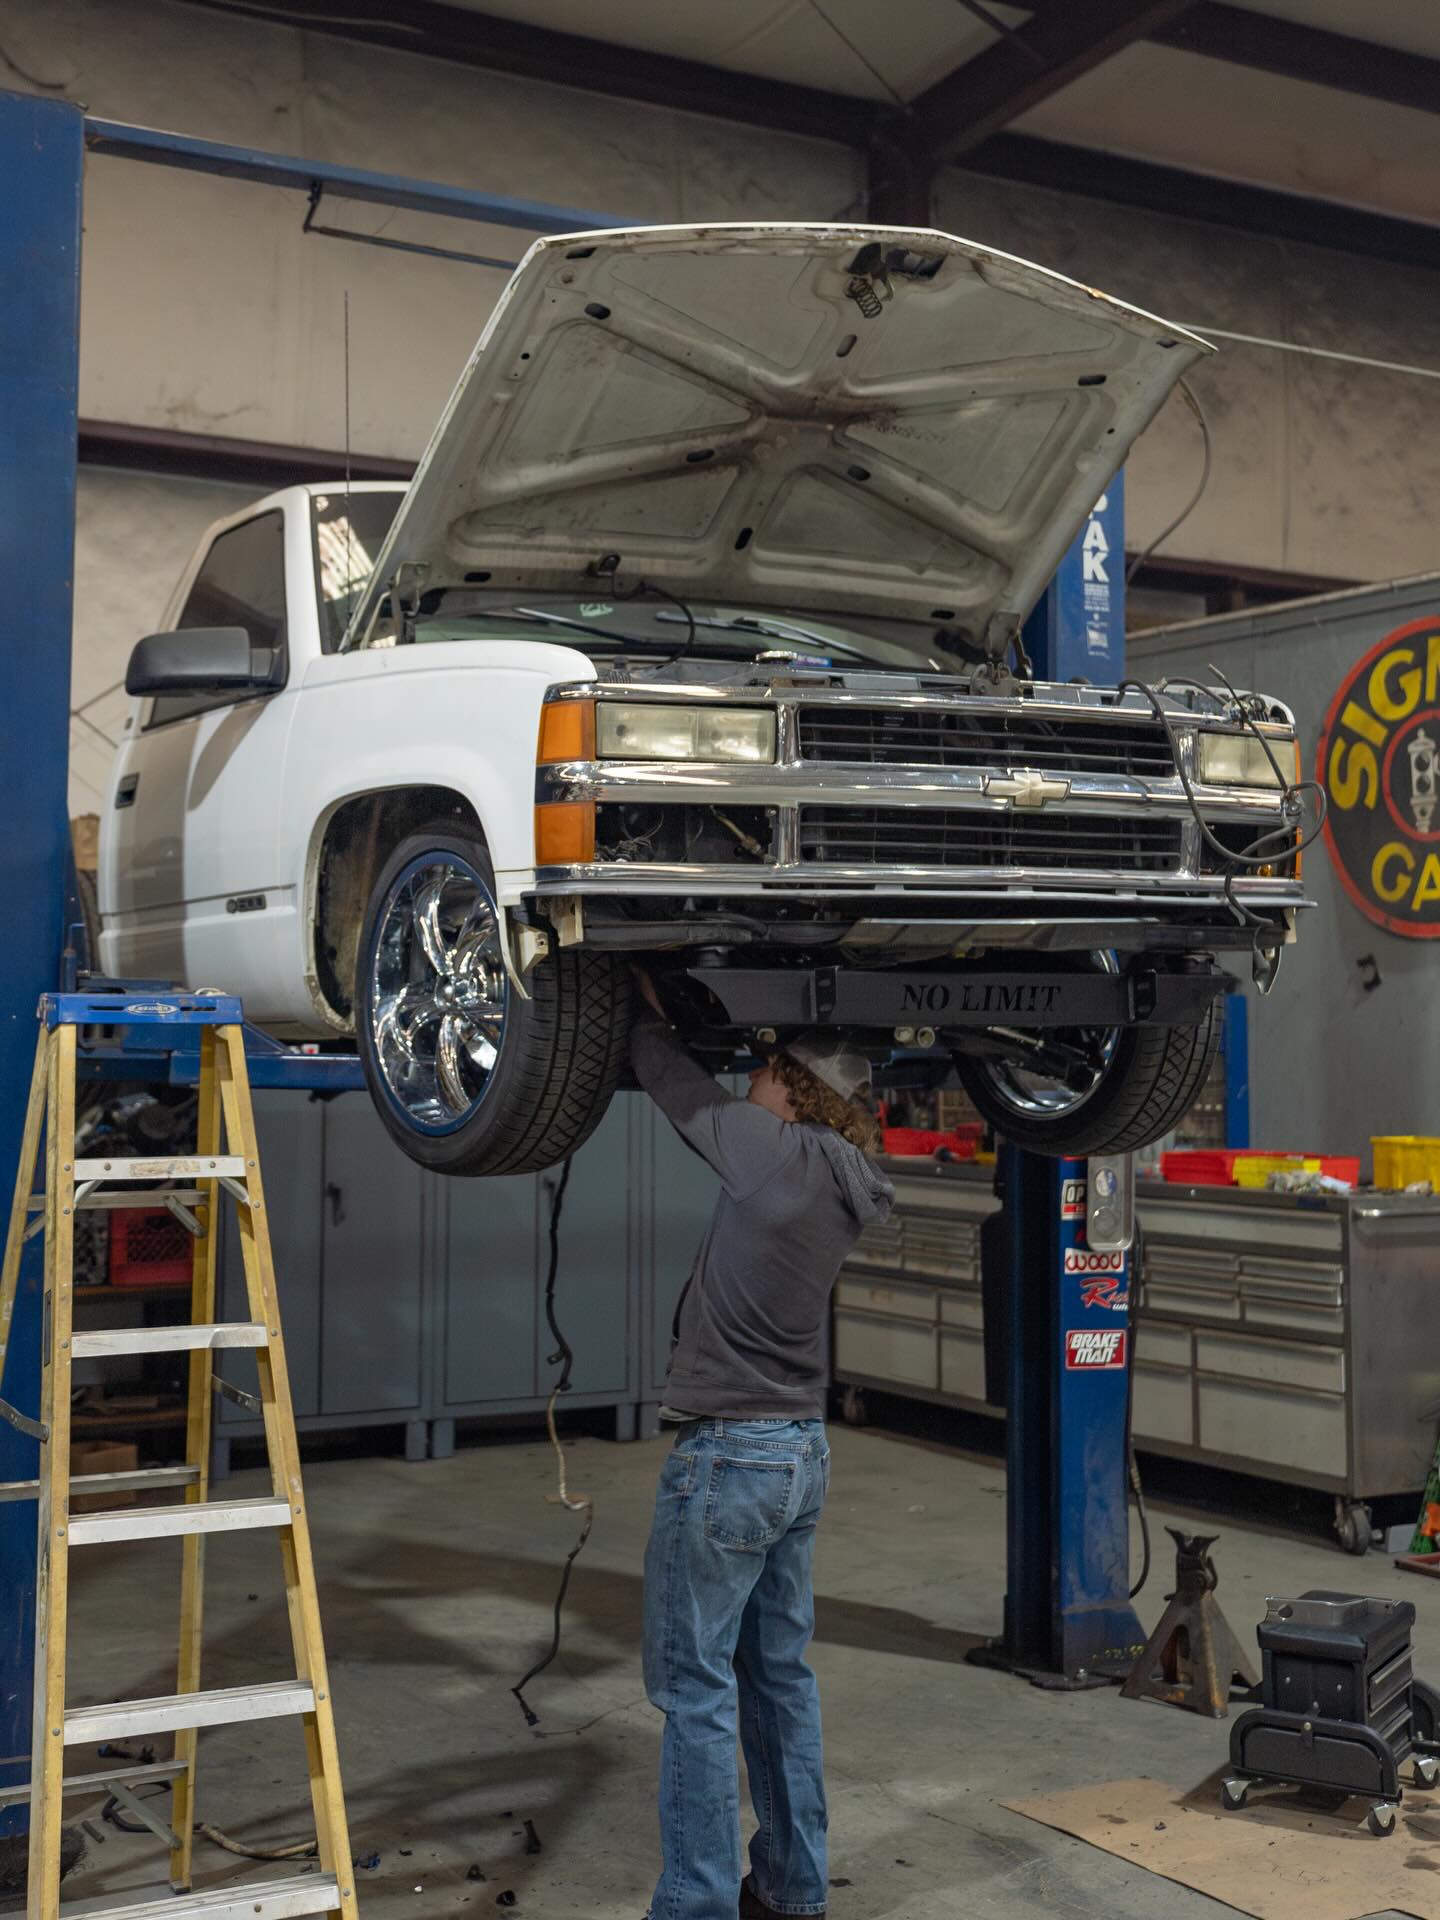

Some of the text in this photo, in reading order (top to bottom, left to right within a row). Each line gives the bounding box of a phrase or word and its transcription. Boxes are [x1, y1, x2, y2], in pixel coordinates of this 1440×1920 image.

[901, 984, 1061, 1012] NO LIMIT
[1070, 1333, 1121, 1349] BRAKE
[1074, 1348, 1114, 1364] MAN
